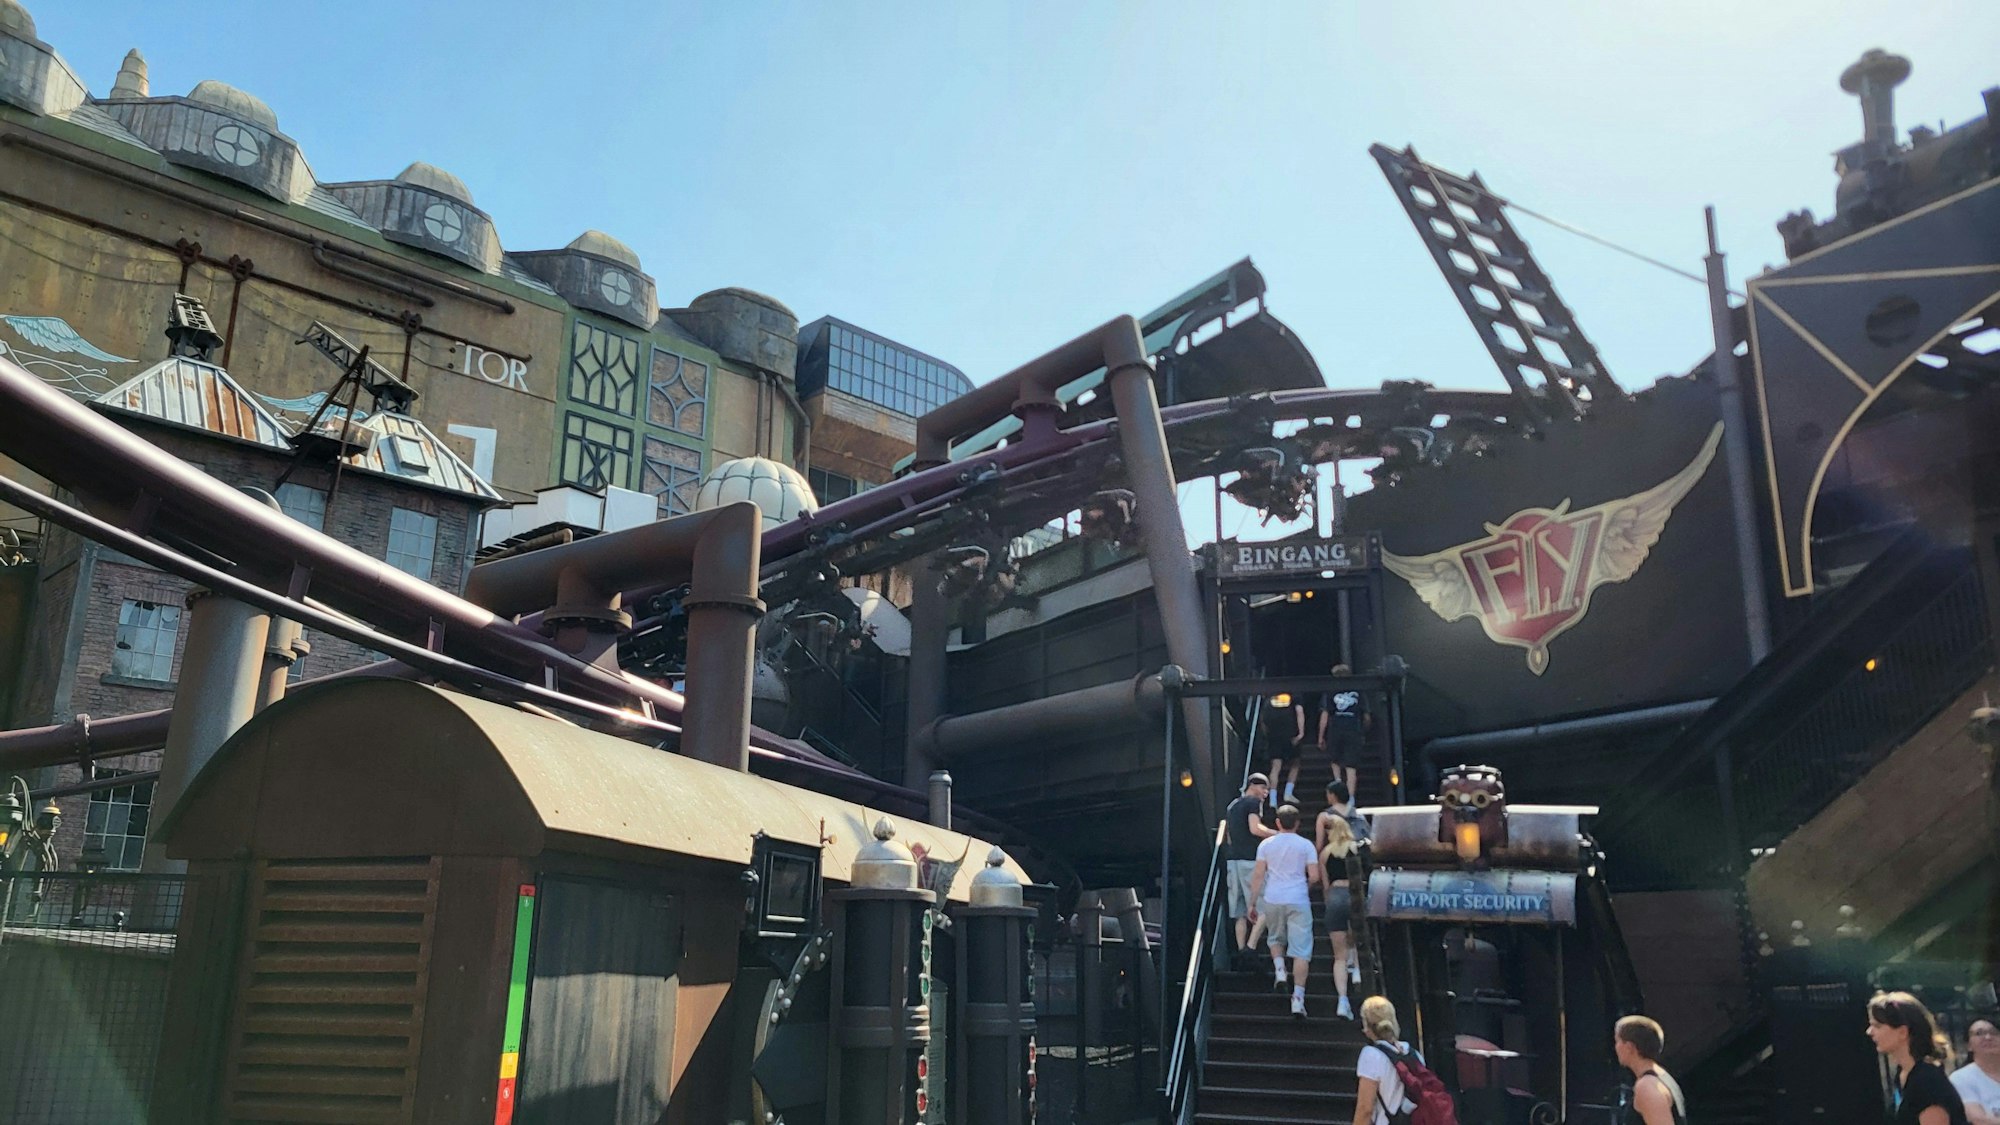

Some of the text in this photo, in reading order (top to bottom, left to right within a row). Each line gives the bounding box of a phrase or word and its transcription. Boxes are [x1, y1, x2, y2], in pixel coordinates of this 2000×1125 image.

[455, 341, 529, 392] TOR
[1238, 543, 1346, 564] EINGANG
[1392, 892, 1544, 911] FLYPORT SECURITY
